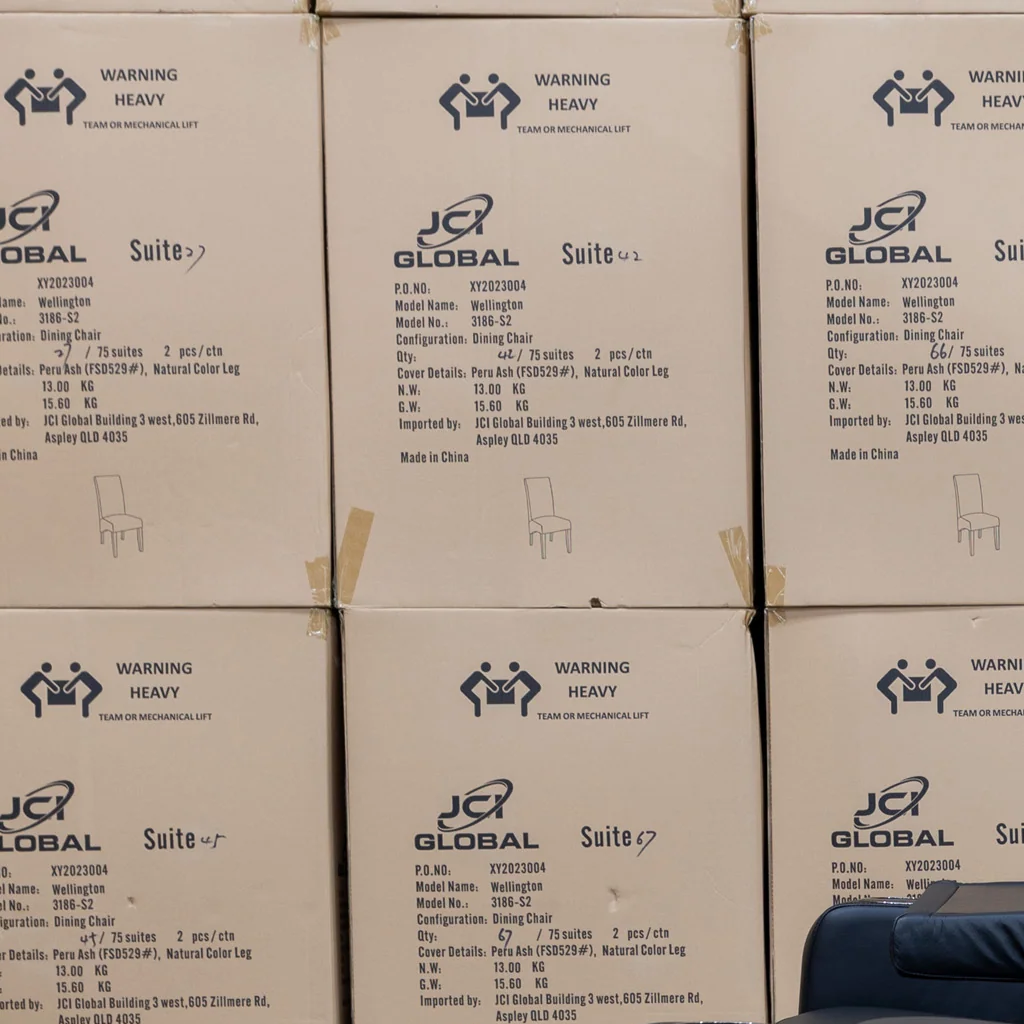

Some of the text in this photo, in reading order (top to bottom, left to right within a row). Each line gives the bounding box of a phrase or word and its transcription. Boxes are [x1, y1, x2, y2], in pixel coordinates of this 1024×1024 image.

[100, 68, 177, 81] WARNING
[534, 73, 610, 86] WARNING
[114, 93, 164, 105] HEAVY
[548, 98, 597, 110] HEAVY
[181, 120, 197, 128] LIFT
[517, 125, 541, 133] TEAM
[542, 125, 555, 133] OR
[557, 125, 612, 133] MECHANICAL
[950, 122, 974, 130] TEAM
[976, 122, 988, 130] OR
[129, 238, 182, 261] Suite
[561, 242, 643, 265] Suite 42
[825, 245, 951, 264] GLOBAL
[393, 248, 519, 268] GLOBAL
[37, 276, 93, 288] XY2023004
[395, 299, 522, 312] Model Name: Wellington
[827, 364, 855, 375] Cover
[858, 363, 896, 375] Details:
[902, 363, 924, 374] Peru
[926, 362, 944, 374] Ash
[399, 417, 443, 431] Imported
[446, 417, 460, 431] by:
[475, 416, 489, 428] JCI
[492, 416, 523, 428] Global
[526, 416, 567, 430] Building
[569, 415, 575, 428] 3
[627, 415, 668, 427] Zillmere
[671, 414, 686, 427] Rd,
[44, 430, 127, 445] Aspley QLD 4035
[116, 661, 192, 674] WARNING
[554, 661, 629, 673] WARNING
[130, 686, 179, 698] HEAVY
[568, 685, 616, 697] HEAVY
[195, 712, 212, 720] LIFT
[537, 712, 561, 720] TEAM
[576, 711, 631, 719] MECHANICAL
[632, 711, 648, 719] LIFT
[143, 827, 195, 850] Suite
[414, 832, 539, 850] GLOBAL
[581, 825, 656, 857] Suite 67
[831, 829, 954, 847] GLOBAL
[51, 863, 108, 876] XY2023004
[489, 861, 545, 874] XY2023004
[905, 859, 960, 871] XY2023004
[832, 878, 893, 889] Model Name:
[416, 912, 552, 927] Configuration: Dining Chair
[93, 1013, 112, 1024] QLD
[115, 1012, 140, 1024] 4035
